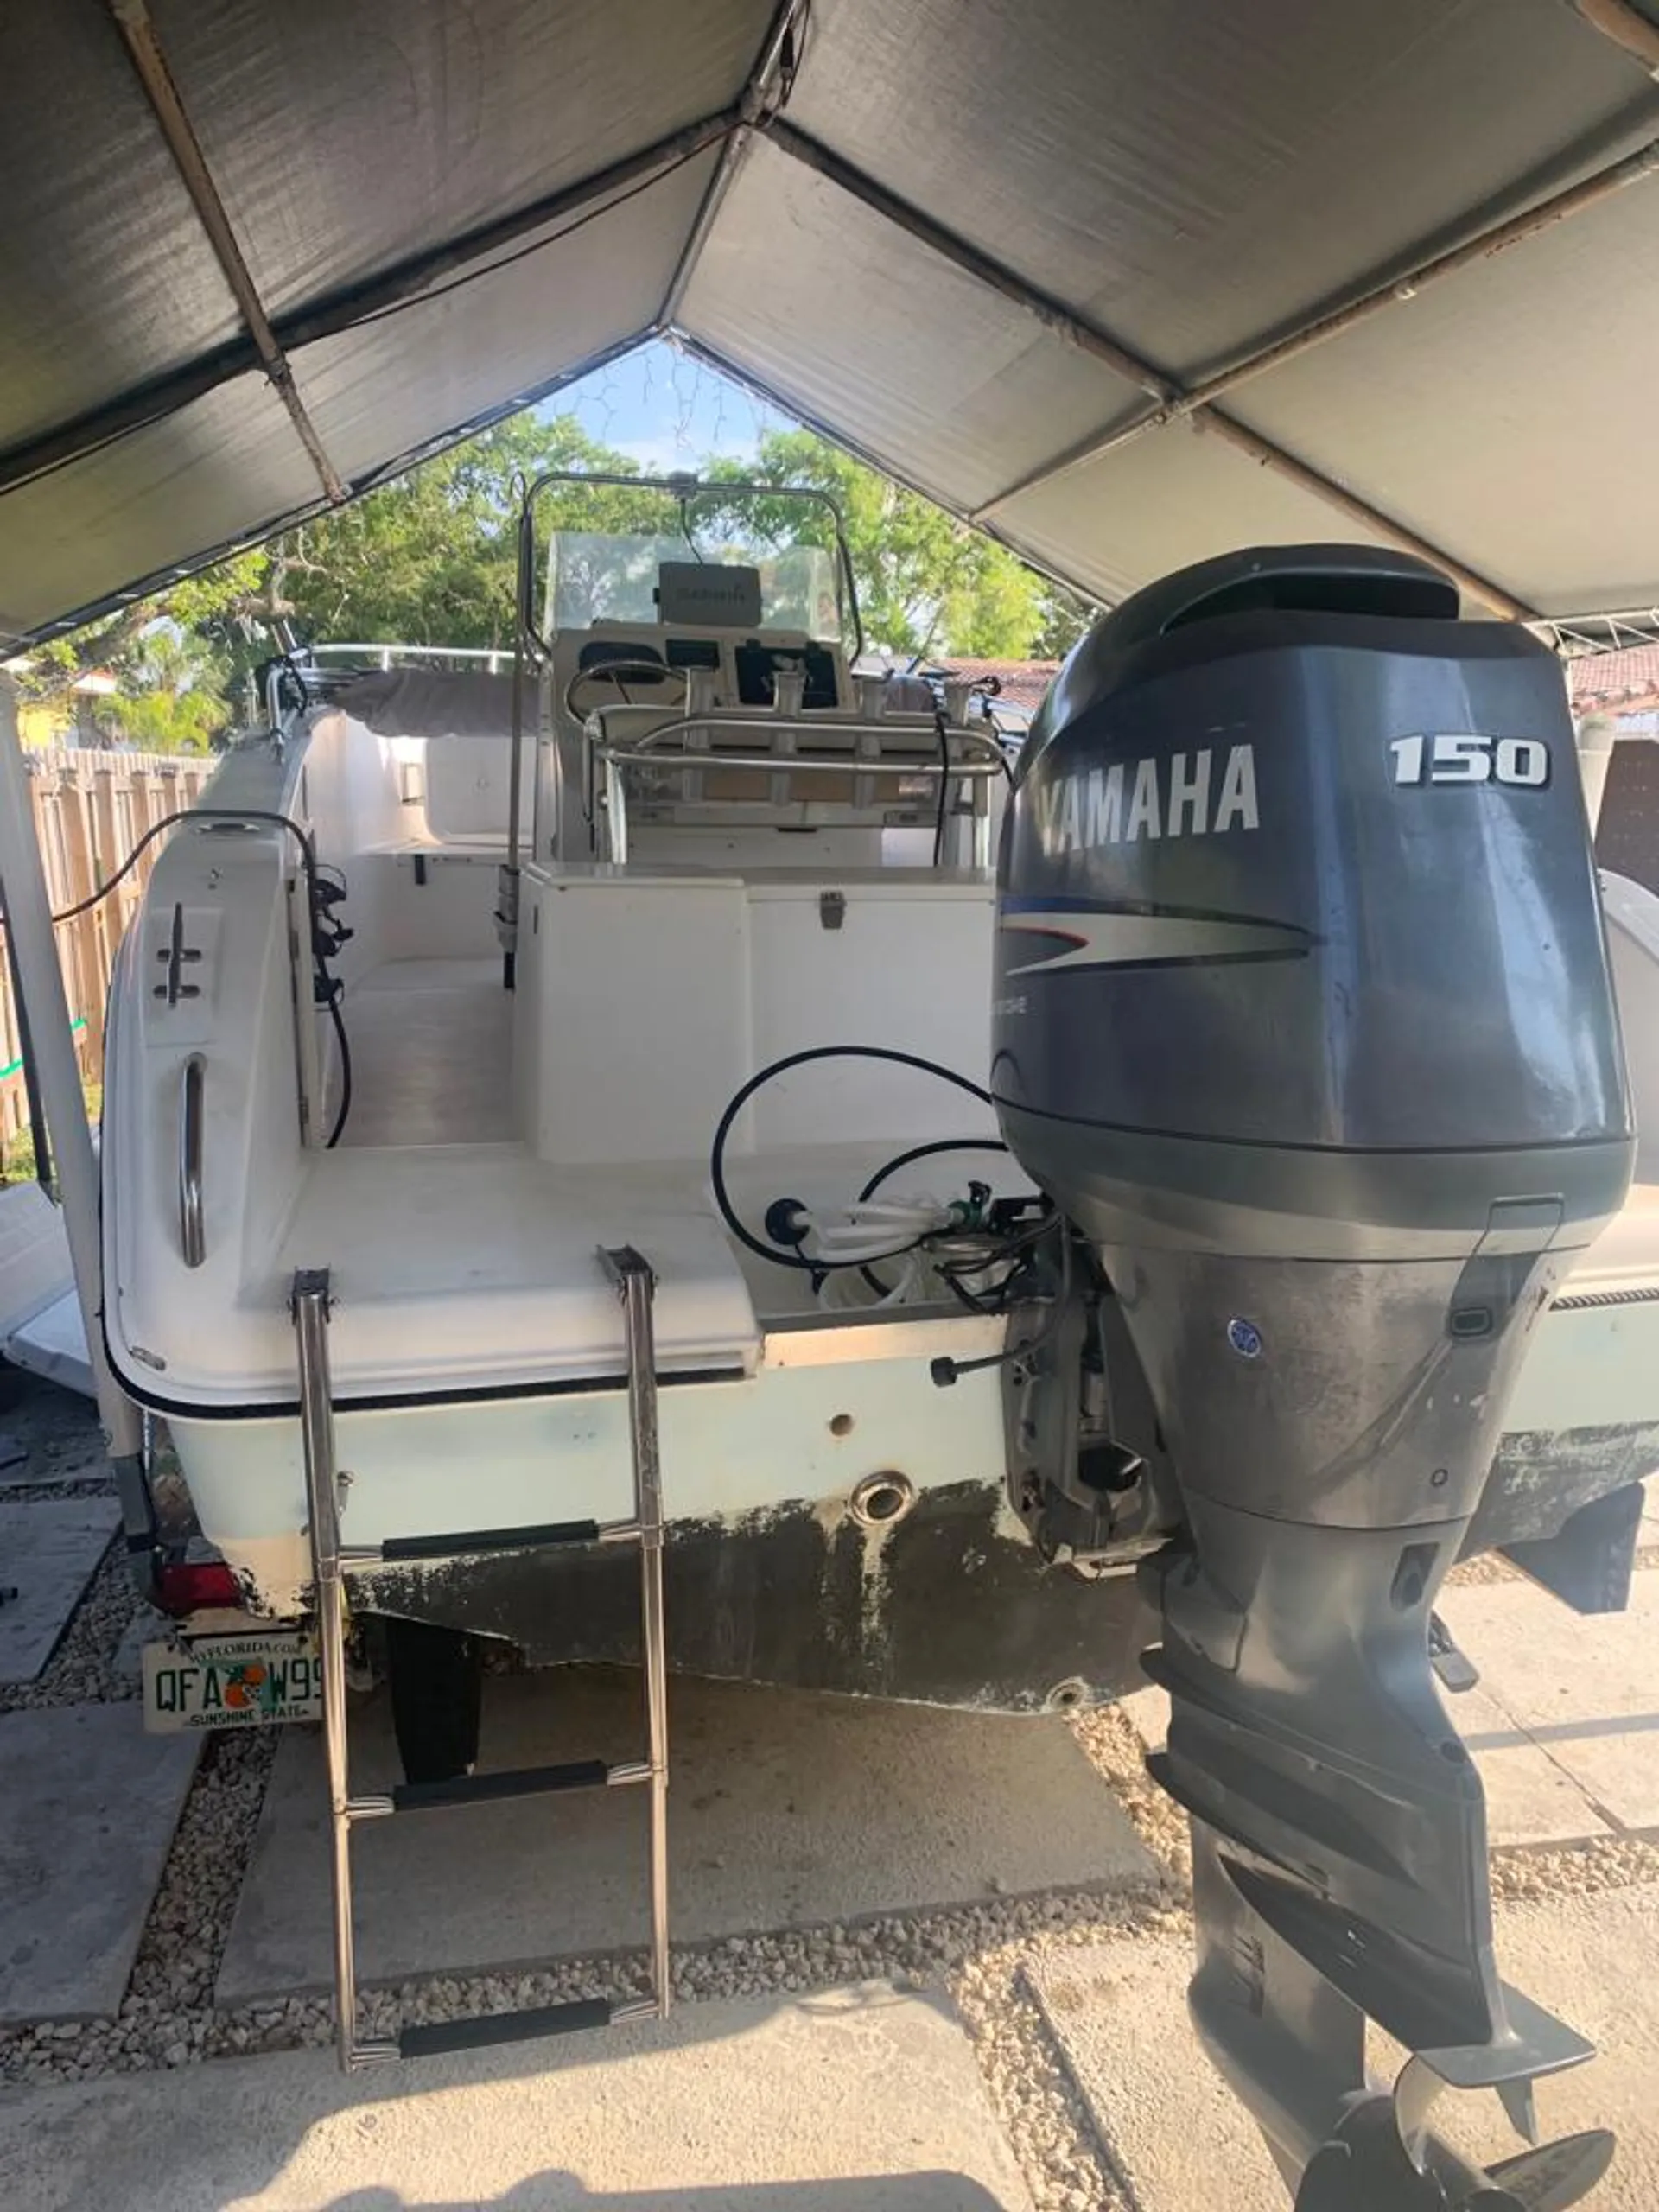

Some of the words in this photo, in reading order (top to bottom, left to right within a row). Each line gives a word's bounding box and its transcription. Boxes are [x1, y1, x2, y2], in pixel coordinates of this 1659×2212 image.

[1389, 734, 1549, 786] 150
[1039, 743, 1260, 858] YAMAHA
[155, 1667, 222, 1712] QFA
[190, 1708, 257, 1727] SUNSHINE
[261, 1704, 301, 1719] STATE
